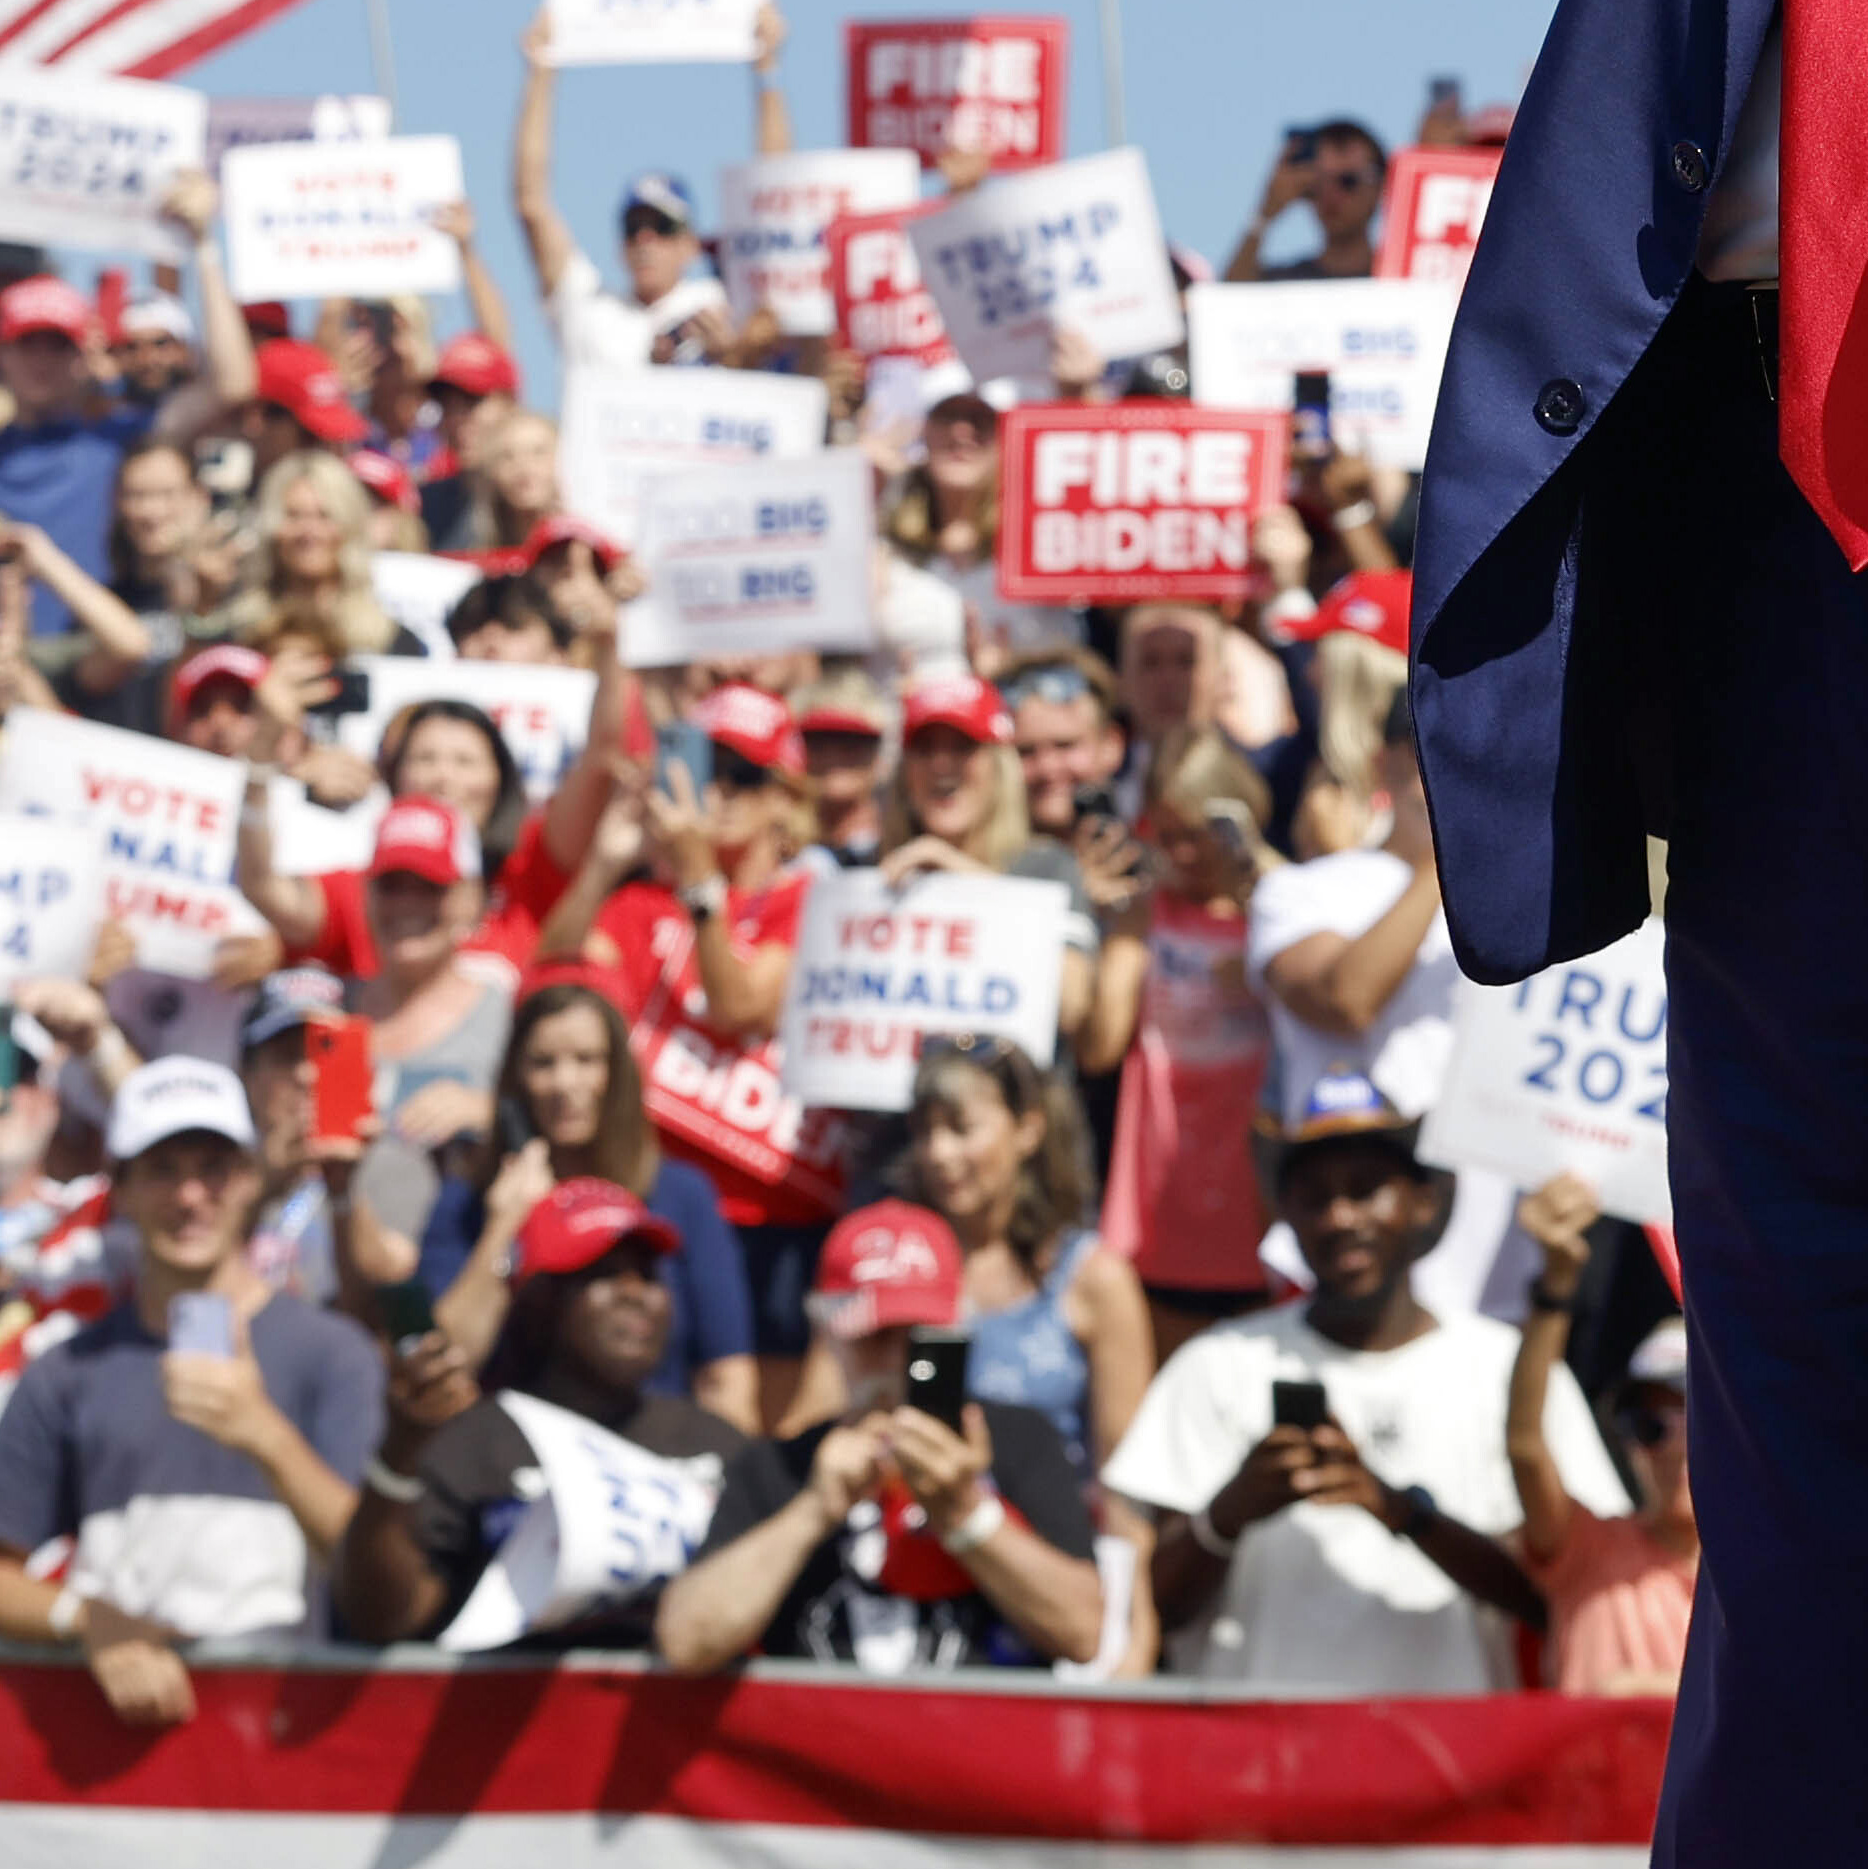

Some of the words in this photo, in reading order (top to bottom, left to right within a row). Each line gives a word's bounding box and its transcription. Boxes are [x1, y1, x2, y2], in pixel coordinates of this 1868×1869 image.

[868, 40, 1042, 102] FIRE
[14, 154, 148, 197] 2024
[847, 228, 924, 299] FI
[938, 202, 1120, 289] TRUMP
[849, 296, 946, 349] BID
[1036, 429, 1251, 506] FIRE
[1035, 510, 1250, 572] BIDEN
[82, 765, 221, 836] VOTE
[104, 874, 229, 933] UMP
[804, 1016, 924, 1062] TRU
[1524, 1031, 1669, 1125] 202
